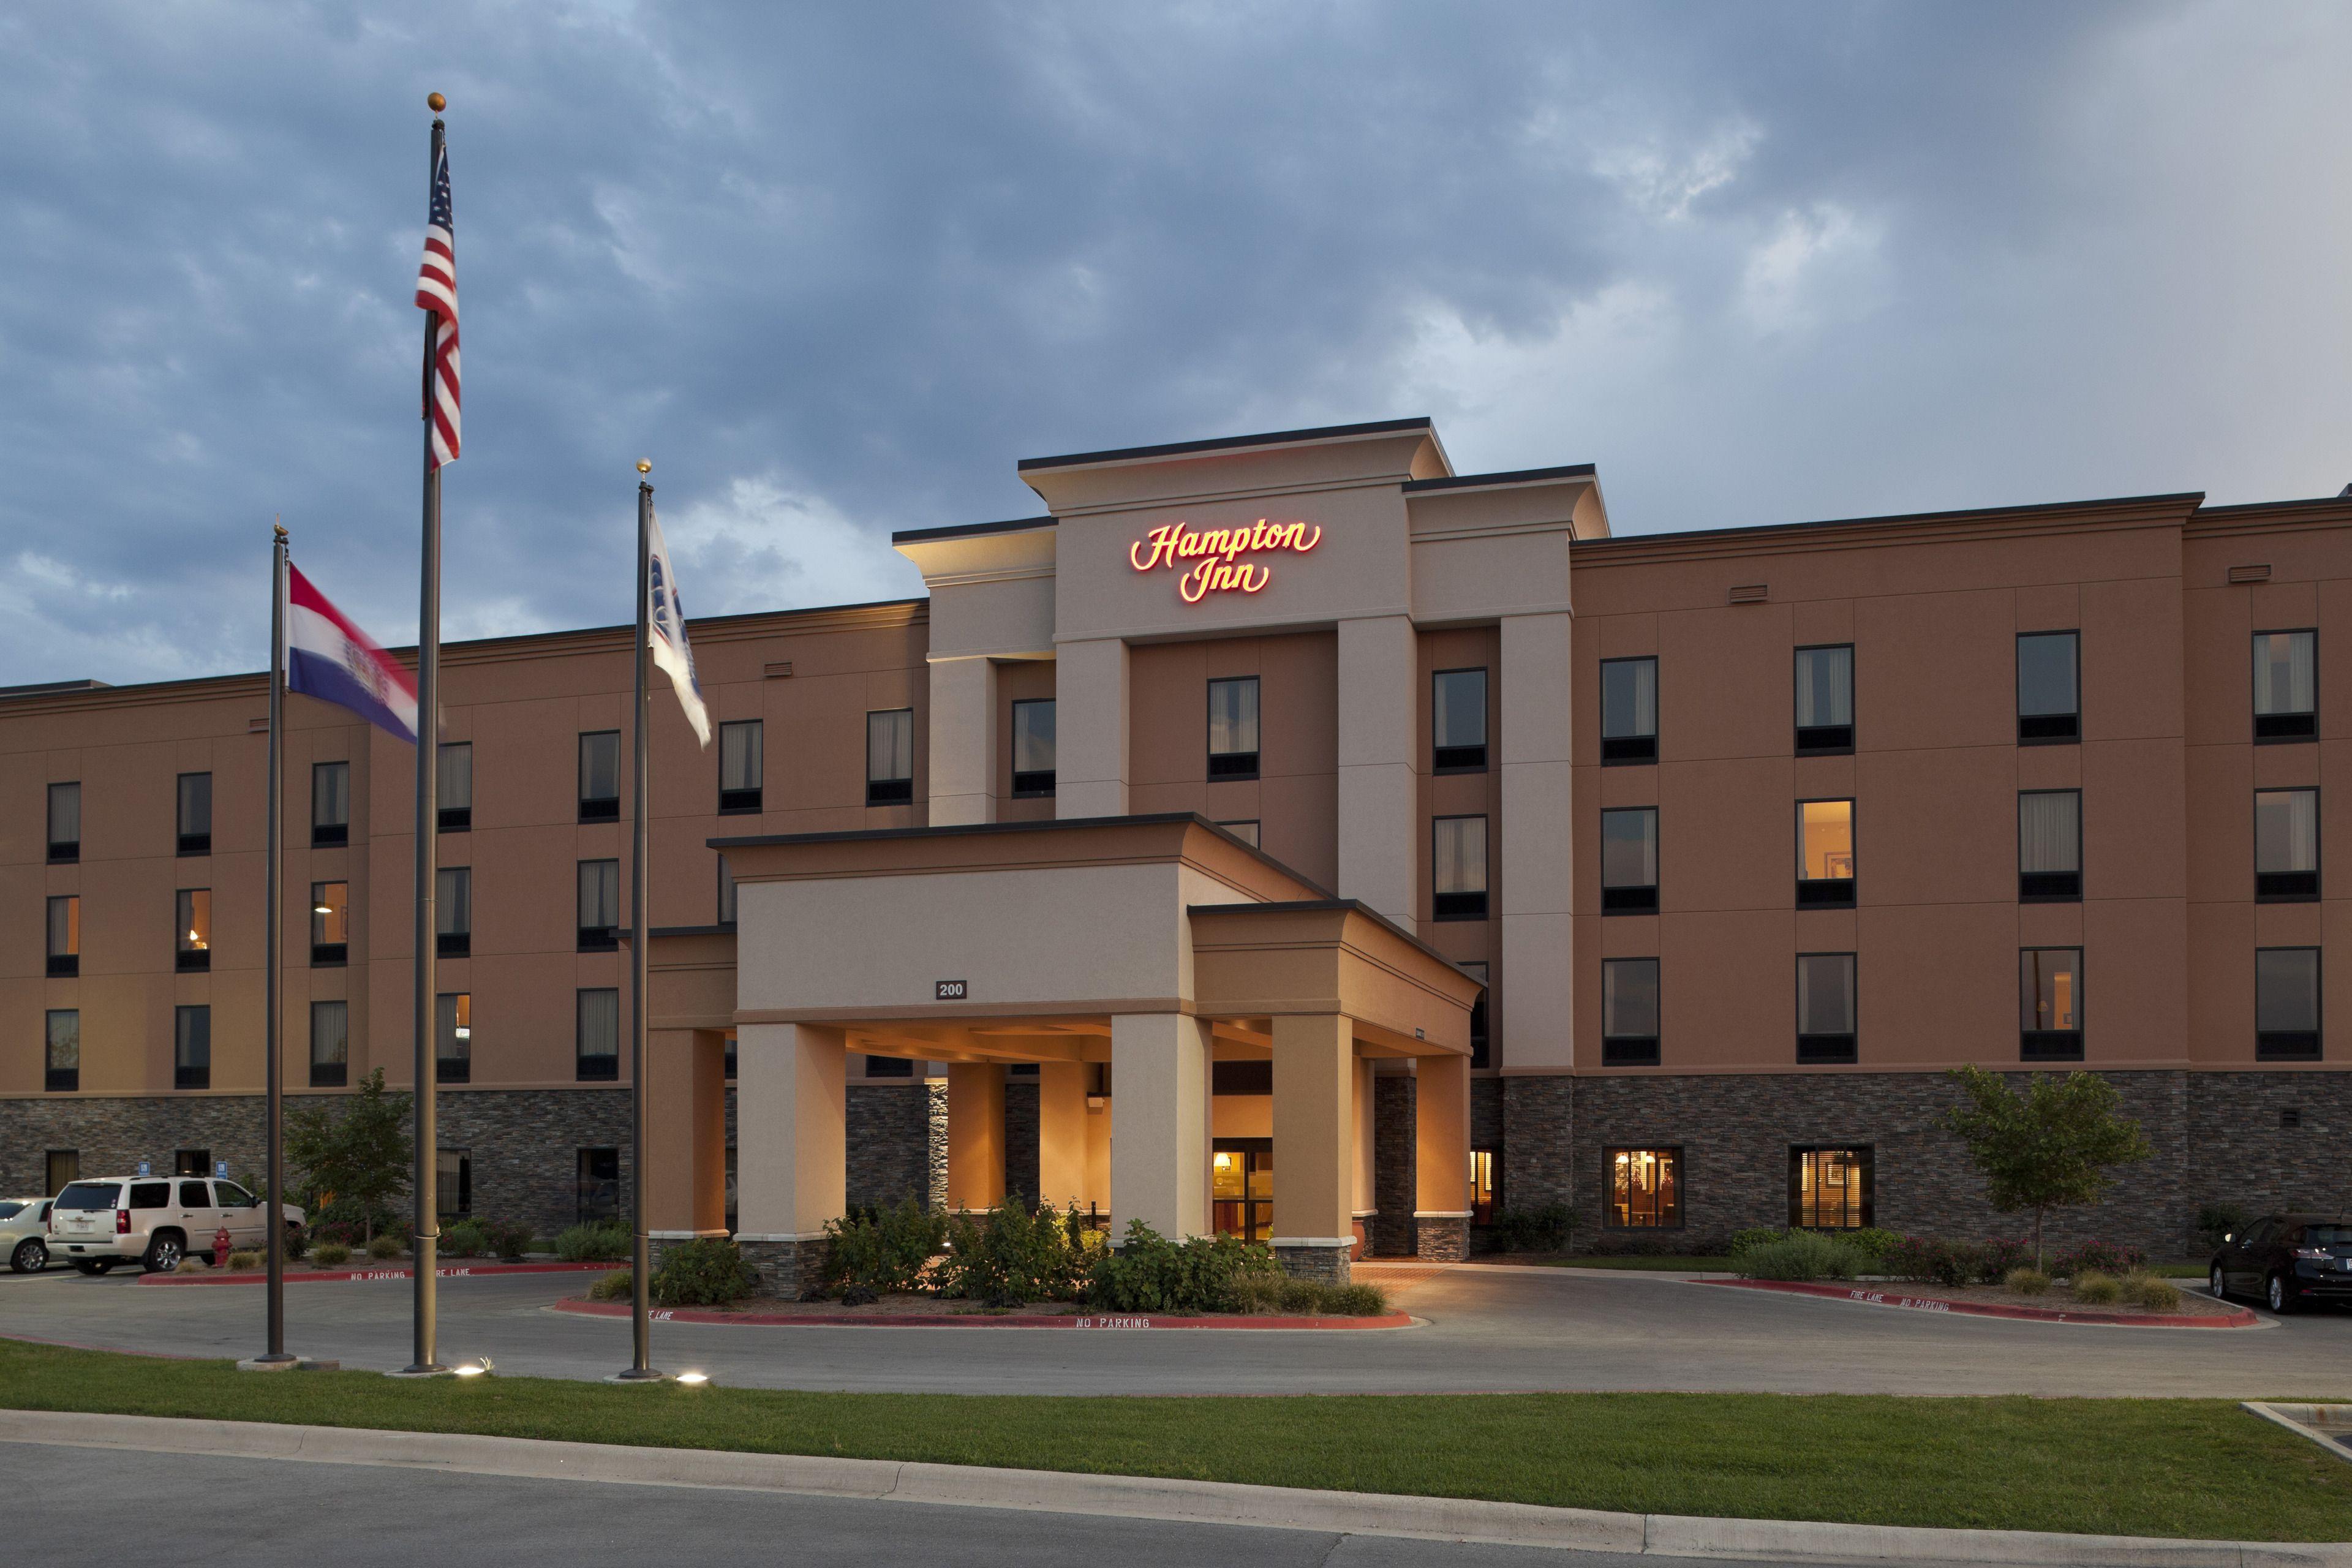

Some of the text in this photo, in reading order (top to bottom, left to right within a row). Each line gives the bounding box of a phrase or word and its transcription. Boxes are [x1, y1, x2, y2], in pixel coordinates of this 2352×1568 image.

[1131, 519, 1321, 570] Hampton
[1180, 556, 1268, 603] Inn
[940, 984, 963, 996] 200
[368, 1271, 405, 1280] PARKING
[435, 1268, 470, 1278] RE LANE
[1850, 1291, 1883, 1303] FIRE LANE
[1901, 1298, 1950, 1311] NO PARKING
[655, 1311, 674, 1320] LANE
[1076, 1317, 1150, 1329] NO PARKING
